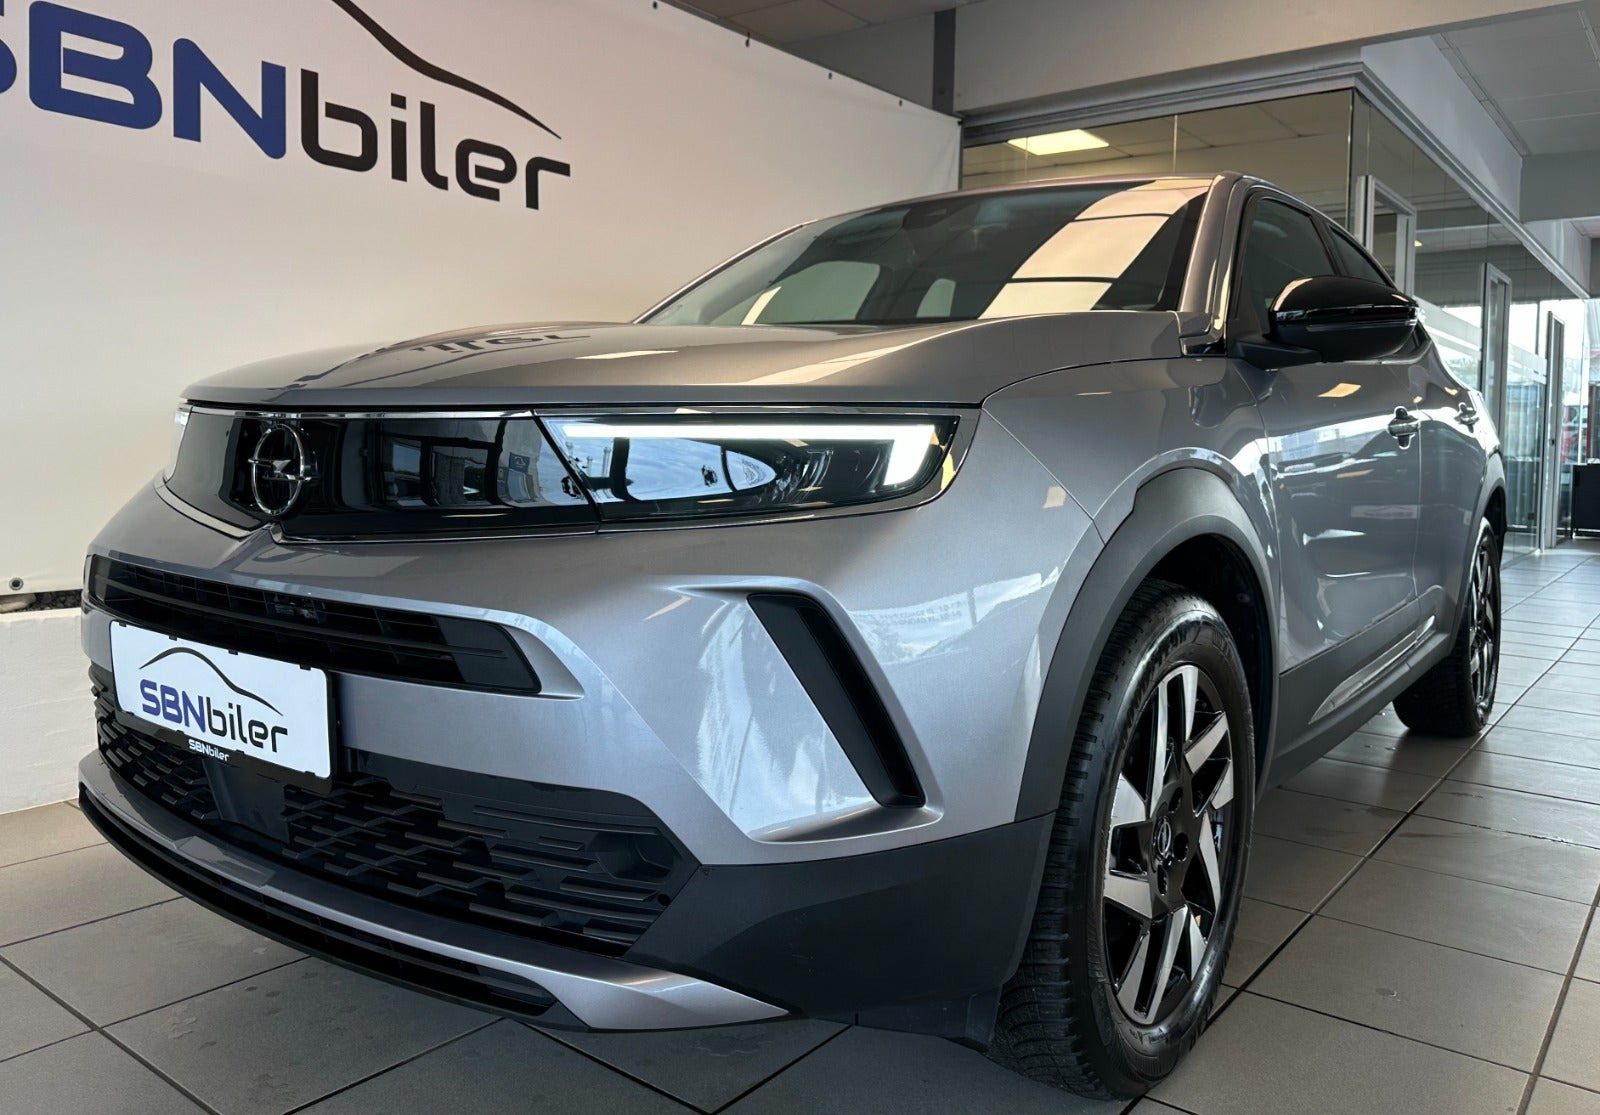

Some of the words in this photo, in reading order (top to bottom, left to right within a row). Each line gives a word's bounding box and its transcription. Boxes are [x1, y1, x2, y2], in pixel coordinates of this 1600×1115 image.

[0, 0, 571, 210] BNbiler
[140, 679, 287, 752] SBNbiler
[188, 739, 229, 762] SBNbiler
